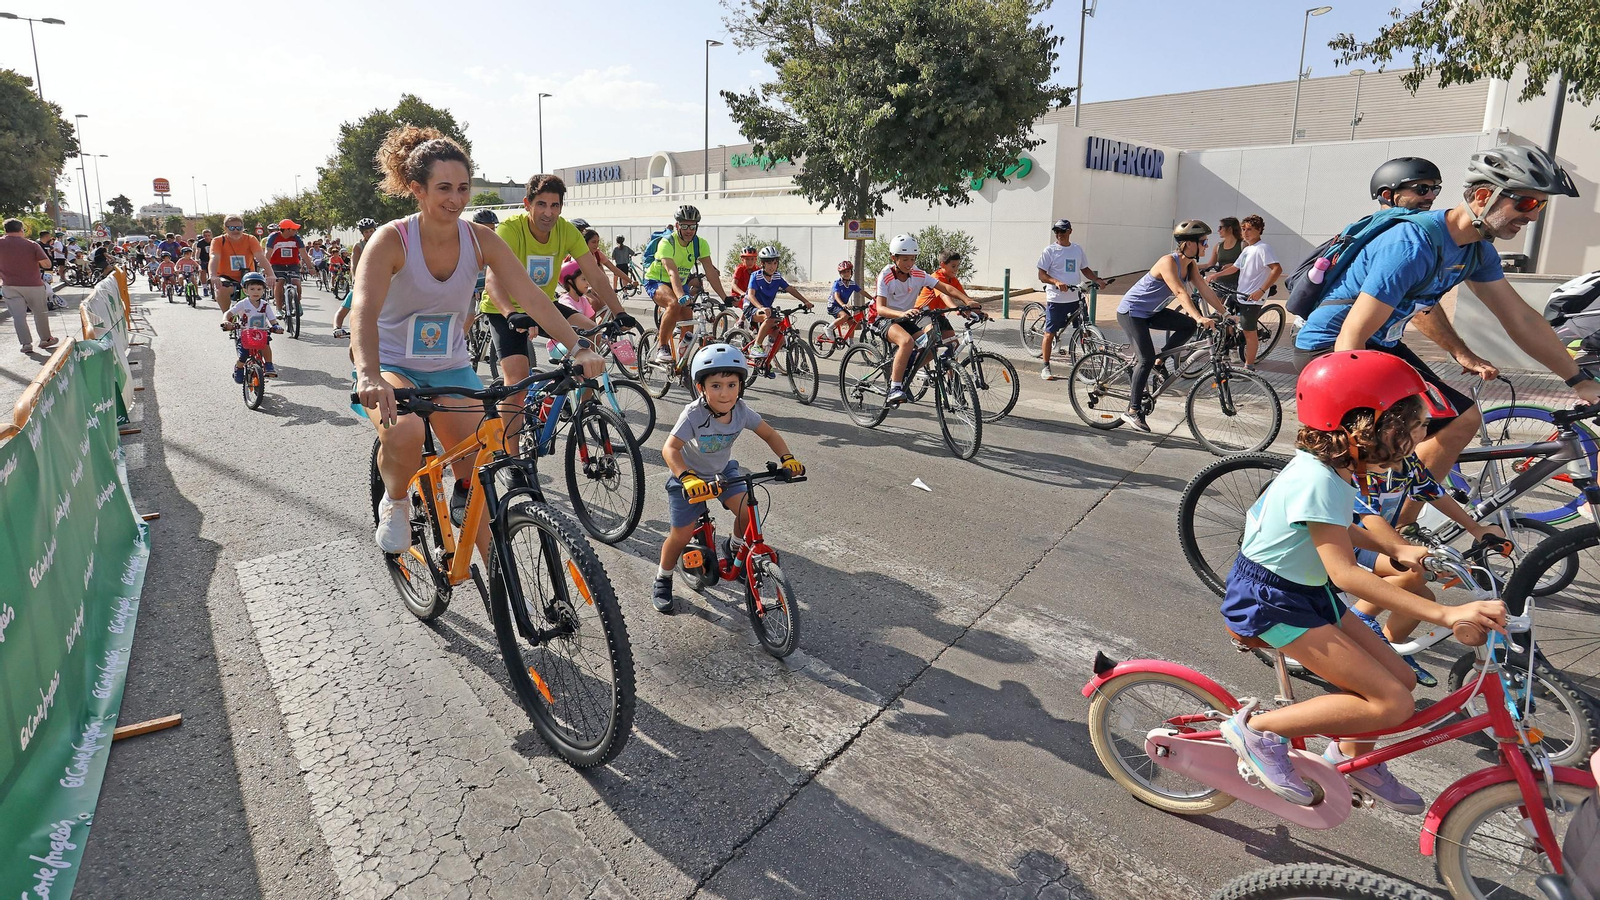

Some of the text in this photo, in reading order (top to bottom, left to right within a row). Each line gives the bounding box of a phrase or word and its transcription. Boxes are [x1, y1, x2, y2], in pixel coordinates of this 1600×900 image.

[1086, 136, 1164, 179] HIPERCOR
[575, 165, 621, 184] HIPERCOR
[1423, 733, 1450, 746] bobbin
[29, 820, 77, 869] Inglés
